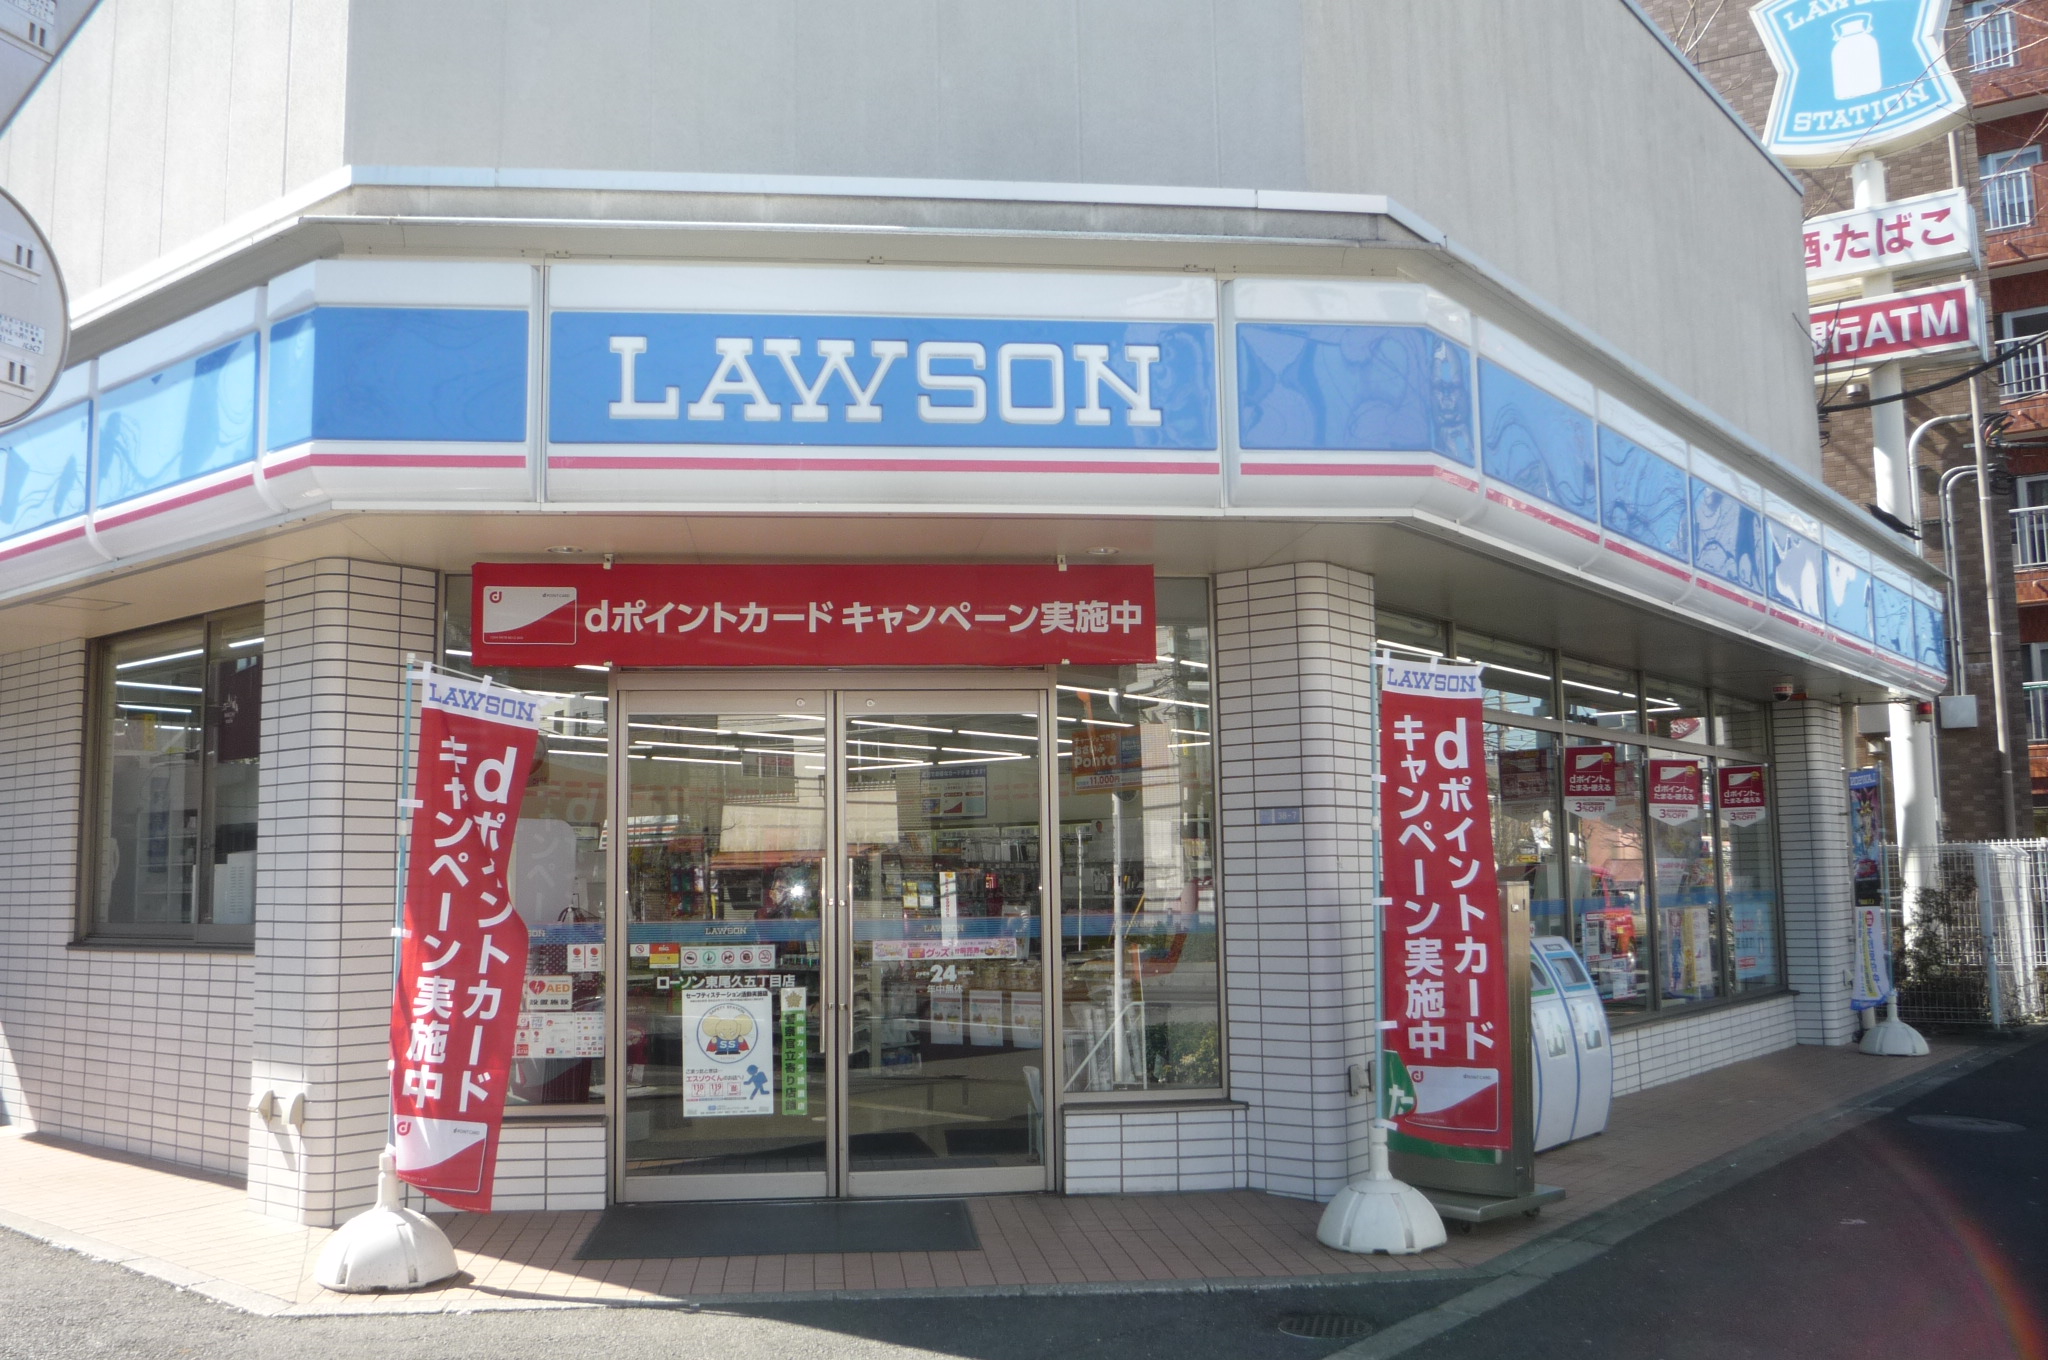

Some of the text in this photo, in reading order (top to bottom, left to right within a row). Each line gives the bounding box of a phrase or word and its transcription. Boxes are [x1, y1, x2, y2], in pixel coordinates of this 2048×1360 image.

[1793, 83, 1930, 132] STATION
[609, 336, 1162, 427] LAWSON
[584, 599, 1142, 635] dポイントカード キャンペーン実施中
[1387, 668, 1476, 693] LAWSON
[429, 683, 536, 722] LAWSON
[1074, 754, 1117, 769] Ponta
[1393, 715, 1446, 1059] キャンペーン実施中
[1435, 718, 1495, 1060] dポイントカード
[401, 736, 474, 1109] キャンペーン実施中
[705, 927, 747, 936] LAWSON
[926, 948, 949, 958] グッズ
[656, 974, 796, 990] ローソン東尾久五丁目店
[930, 964, 957, 983] 24
[546, 984, 571, 993] AED
[927, 984, 963, 994] 年中無休
[719, 1040, 736, 1049] SS
